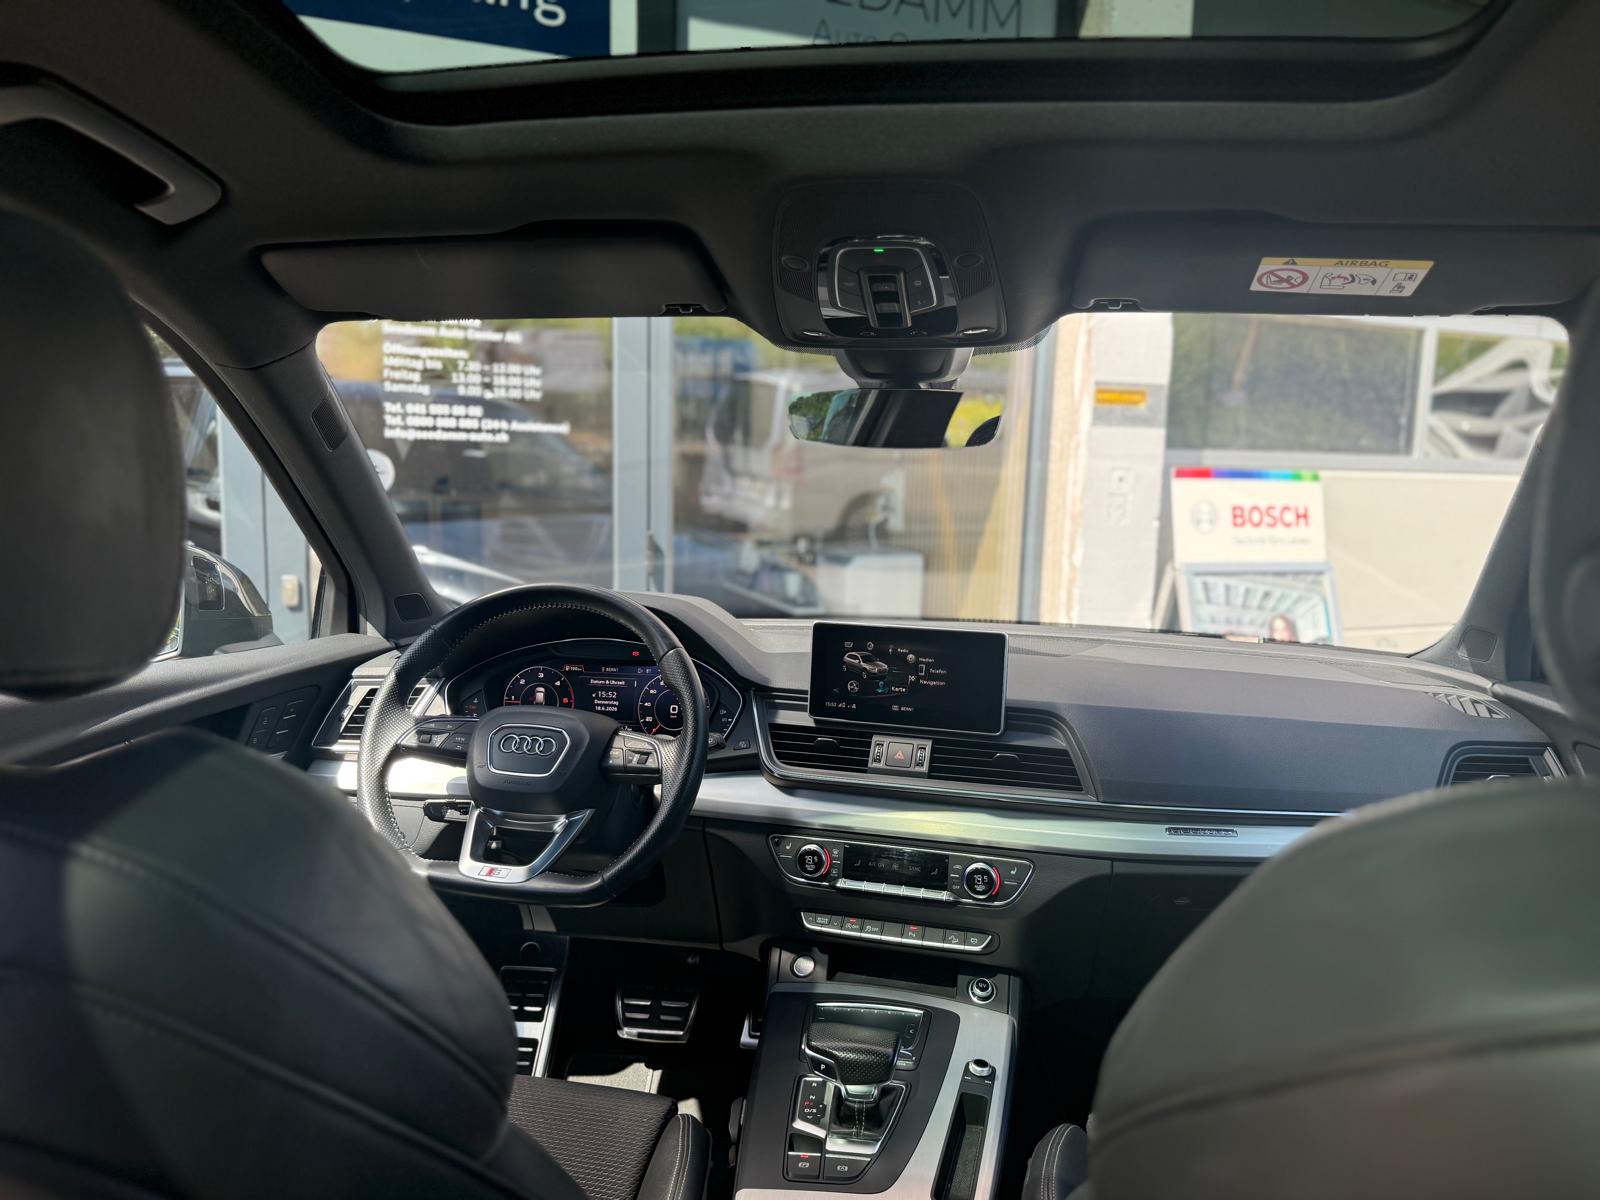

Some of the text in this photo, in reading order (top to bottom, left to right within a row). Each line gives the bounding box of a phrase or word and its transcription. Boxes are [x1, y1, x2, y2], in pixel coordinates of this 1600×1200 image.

[523, 364, 542, 376] Uhr
[523, 377, 542, 388] Uhr
[523, 389, 542, 401] Uhr
[383, 401, 404, 413] Tel.
[384, 413, 405, 426] Tel.
[1231, 505, 1310, 528] BOSCH
[670, 705, 679, 713] 0
